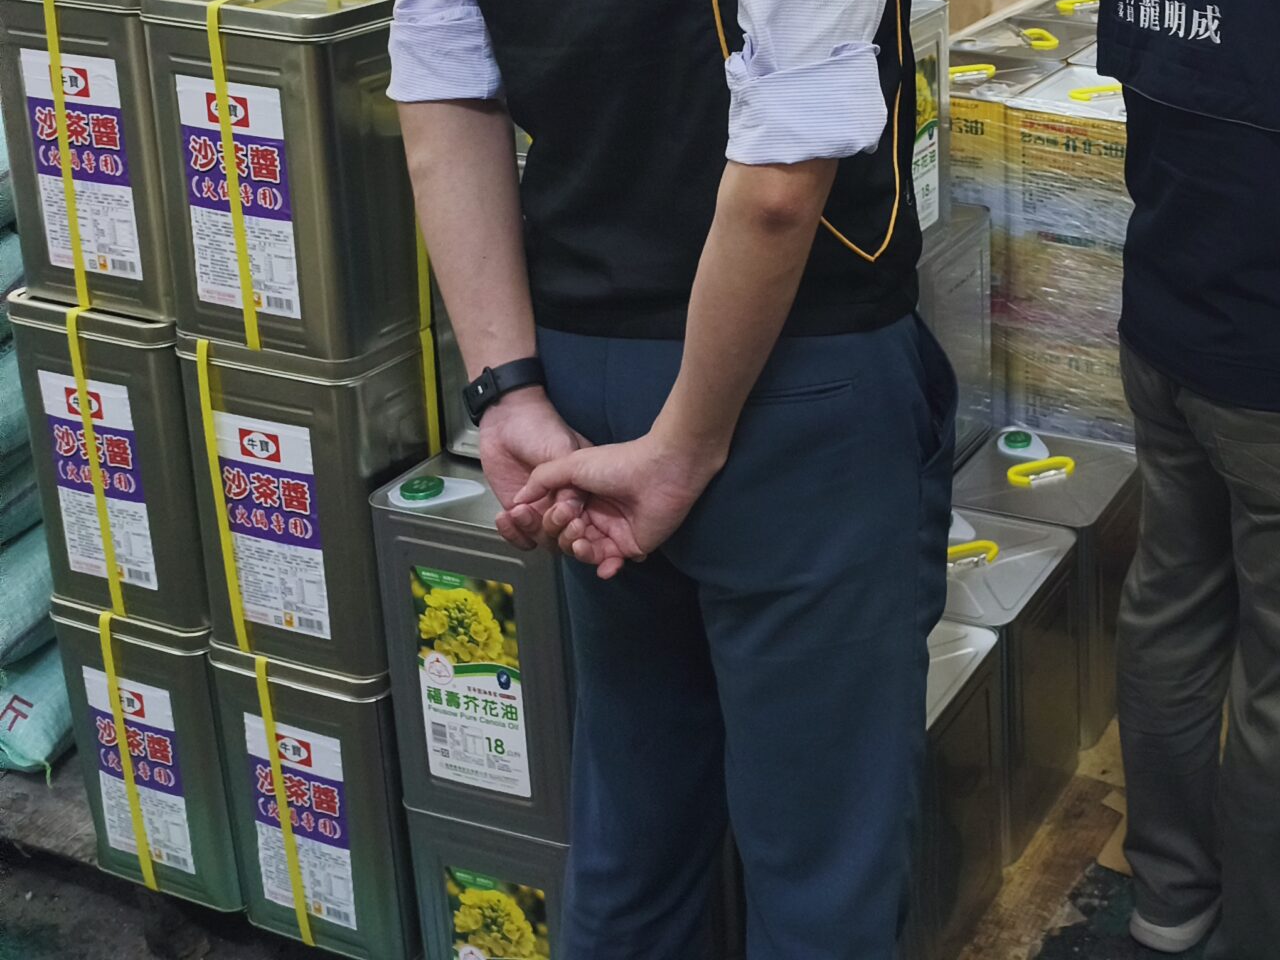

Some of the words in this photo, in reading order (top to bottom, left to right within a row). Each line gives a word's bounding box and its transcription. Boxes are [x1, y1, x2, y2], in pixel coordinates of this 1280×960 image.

[36, 106, 120, 150] 沙茶醬
[223, 466, 310, 515] 沙茶醬
[426, 685, 518, 722] 福壽芥花油
[485, 736, 506, 755] 18
